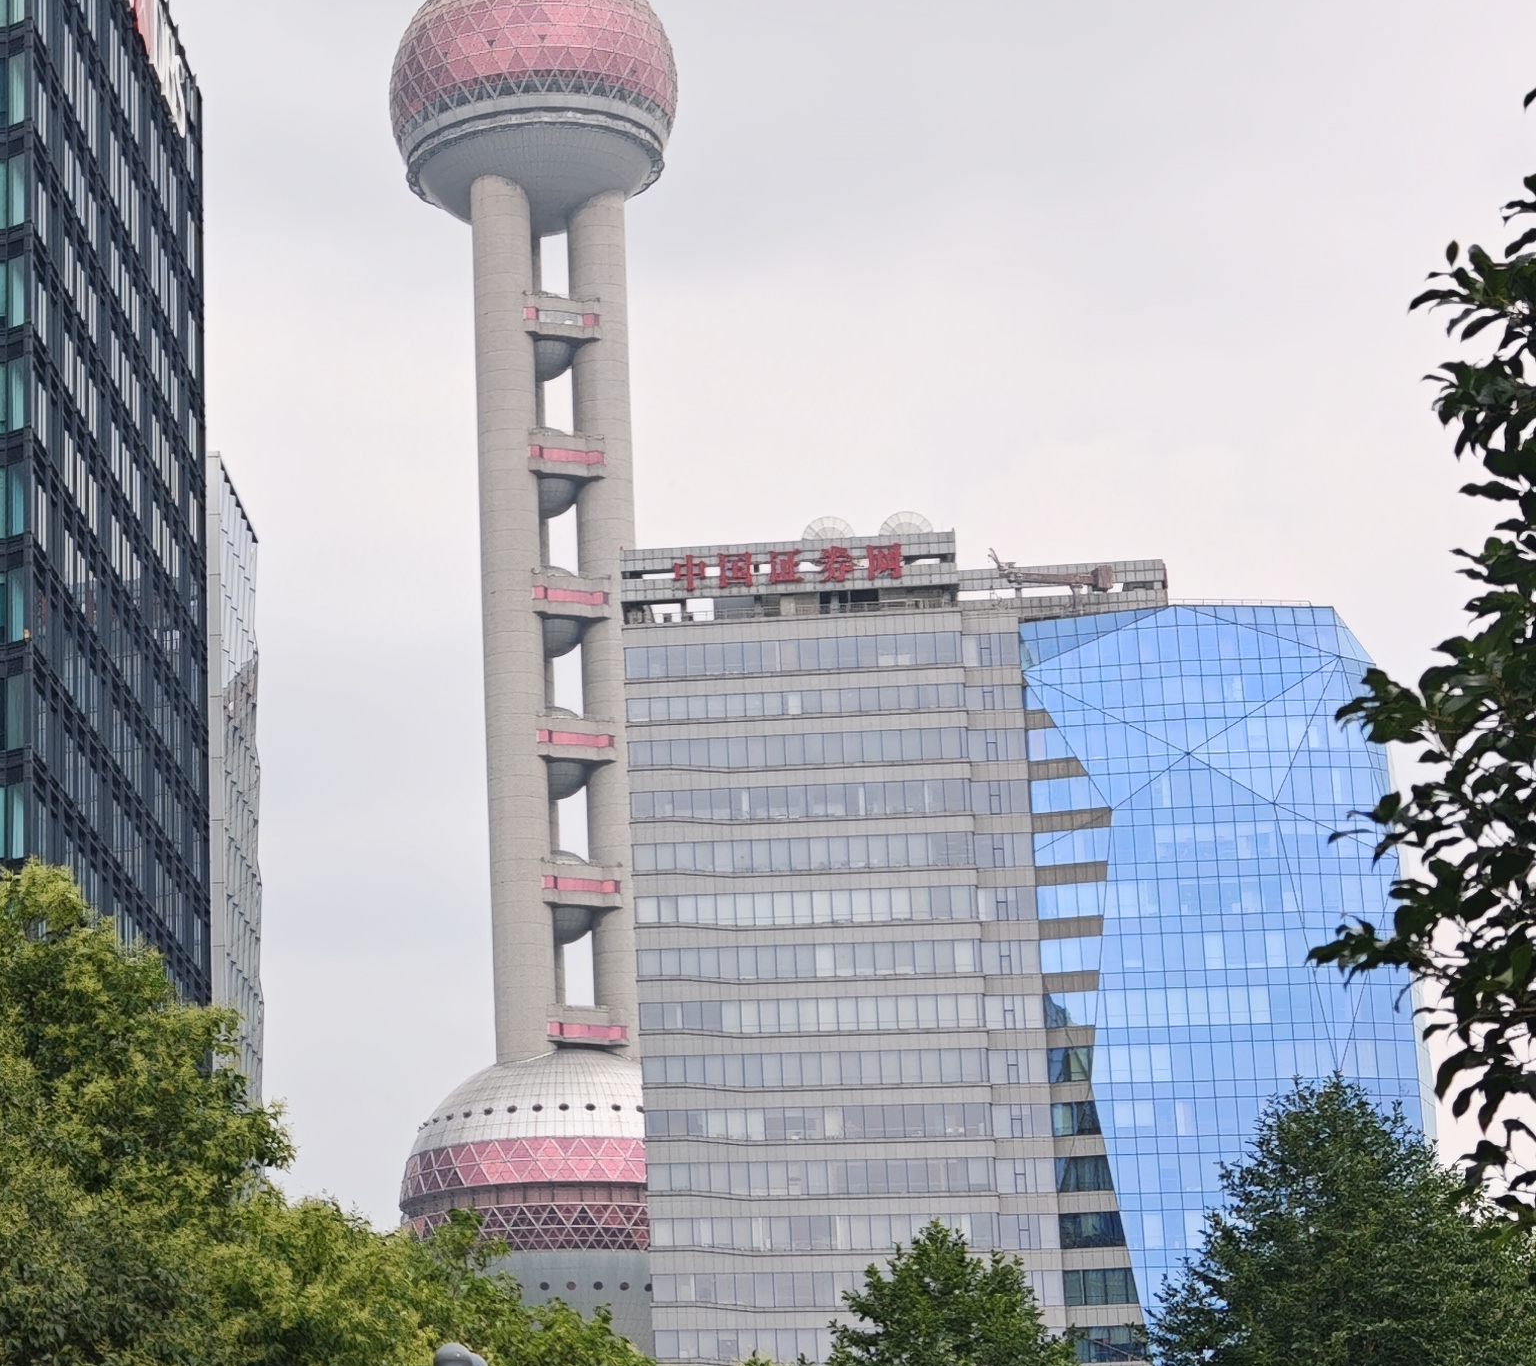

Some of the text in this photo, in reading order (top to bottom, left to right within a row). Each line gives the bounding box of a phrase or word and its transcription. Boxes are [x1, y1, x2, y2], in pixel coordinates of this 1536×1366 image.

[672, 543, 903, 591] 中国证券网
